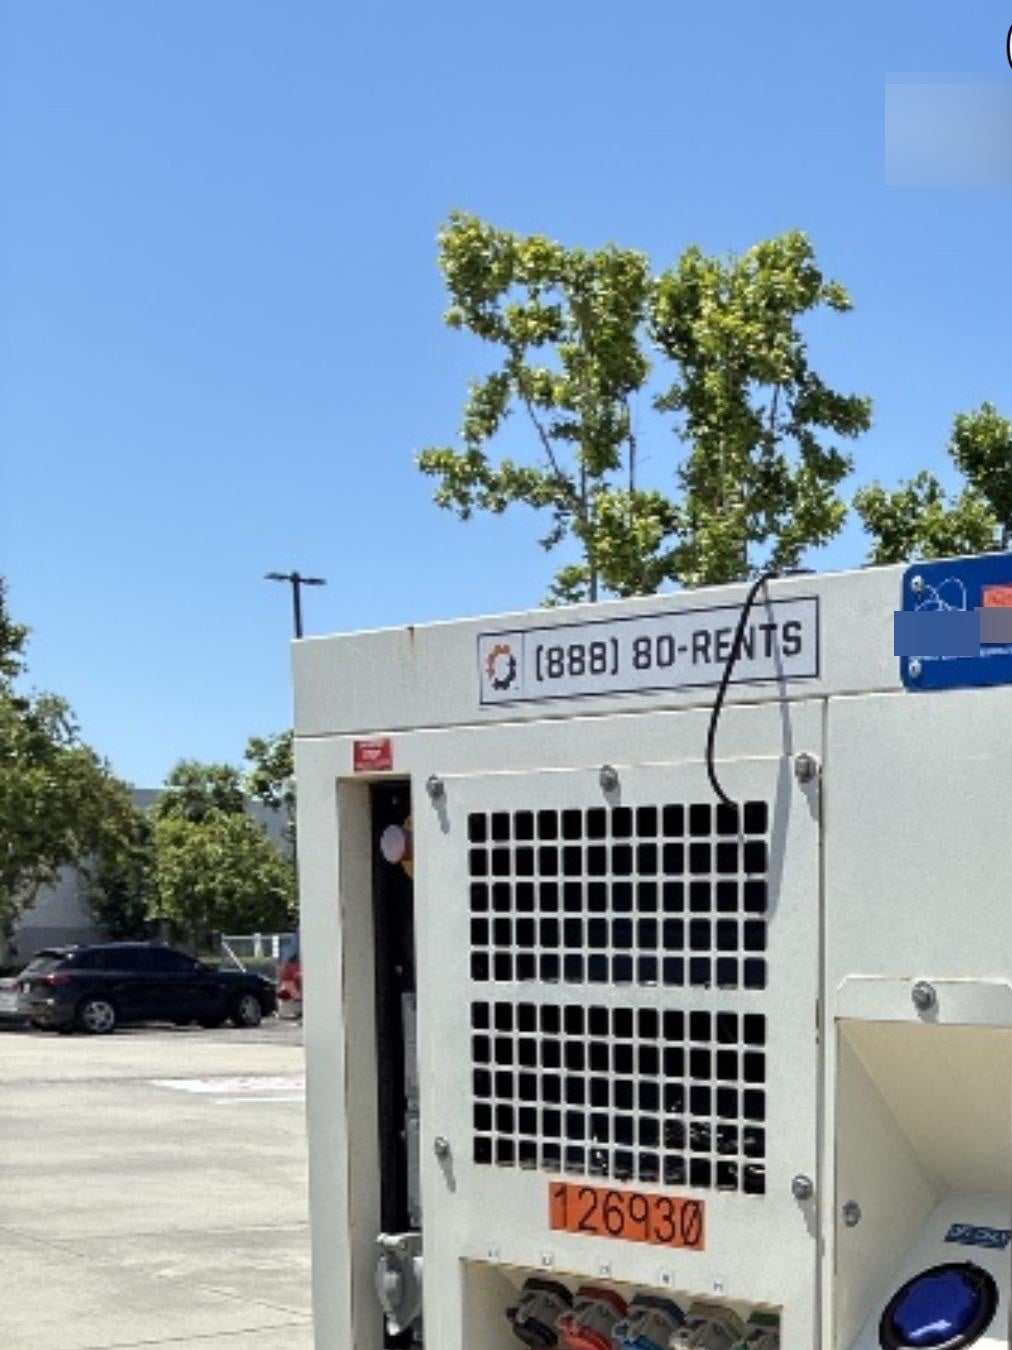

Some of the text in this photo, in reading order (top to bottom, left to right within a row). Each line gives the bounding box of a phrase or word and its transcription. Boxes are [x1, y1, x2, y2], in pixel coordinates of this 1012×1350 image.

[535, 619, 803, 681] (888) 80-RENTS
[553, 1184, 703, 1246] 126930
